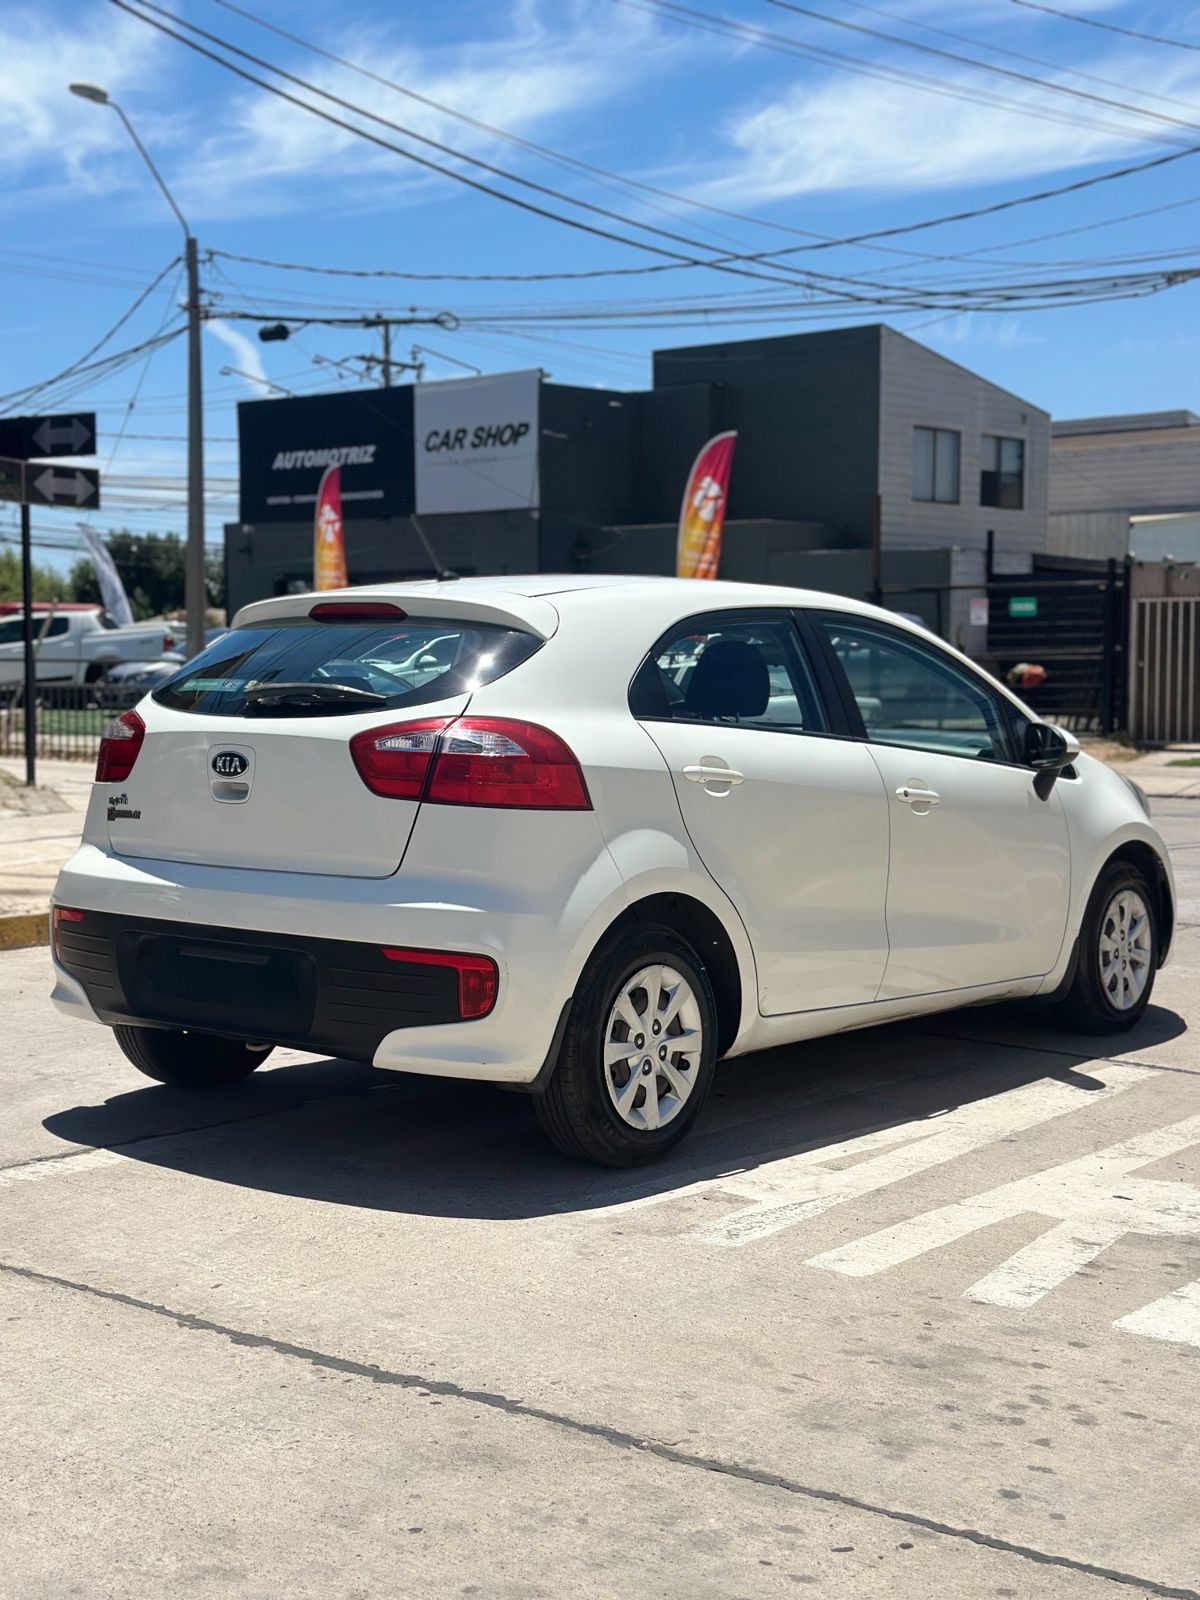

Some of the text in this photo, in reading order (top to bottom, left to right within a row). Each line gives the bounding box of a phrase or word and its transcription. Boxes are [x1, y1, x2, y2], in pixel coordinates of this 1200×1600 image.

[425, 423, 529, 452] CAR SHOP
[272, 444, 377, 470] AUTOMOTRIZ
[216, 756, 242, 772] KIA
